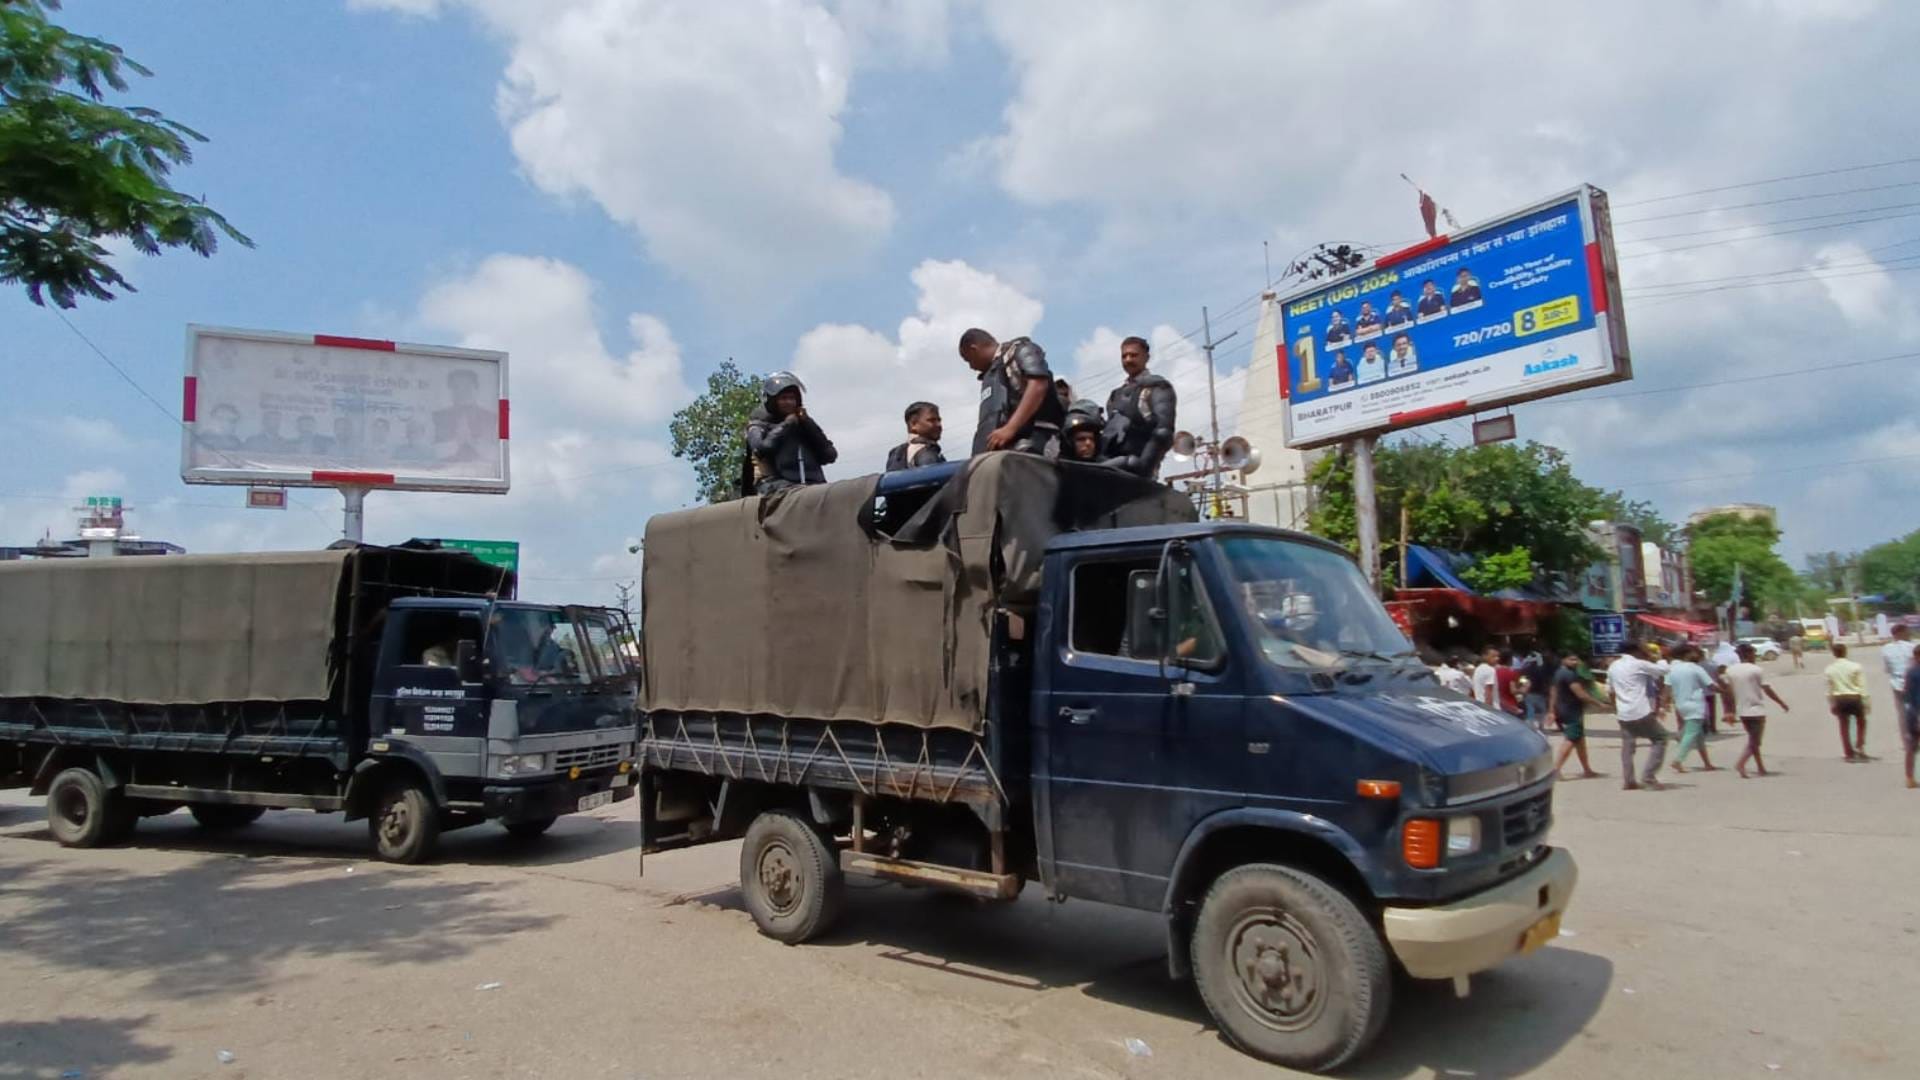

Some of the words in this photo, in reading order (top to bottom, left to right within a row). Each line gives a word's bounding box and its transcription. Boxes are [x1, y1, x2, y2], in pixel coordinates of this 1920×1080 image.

[1290, 294, 1325, 317] NEET
[1327, 284, 1359, 306] (UG)
[1361, 272, 1399, 294] 2024
[1453, 322, 1511, 348] 720/720
[1520, 311, 1536, 332] 8
[1297, 335, 1322, 393] 1
[1523, 354, 1579, 376] Aakash
[1297, 402, 1353, 421] BHARATPUR
